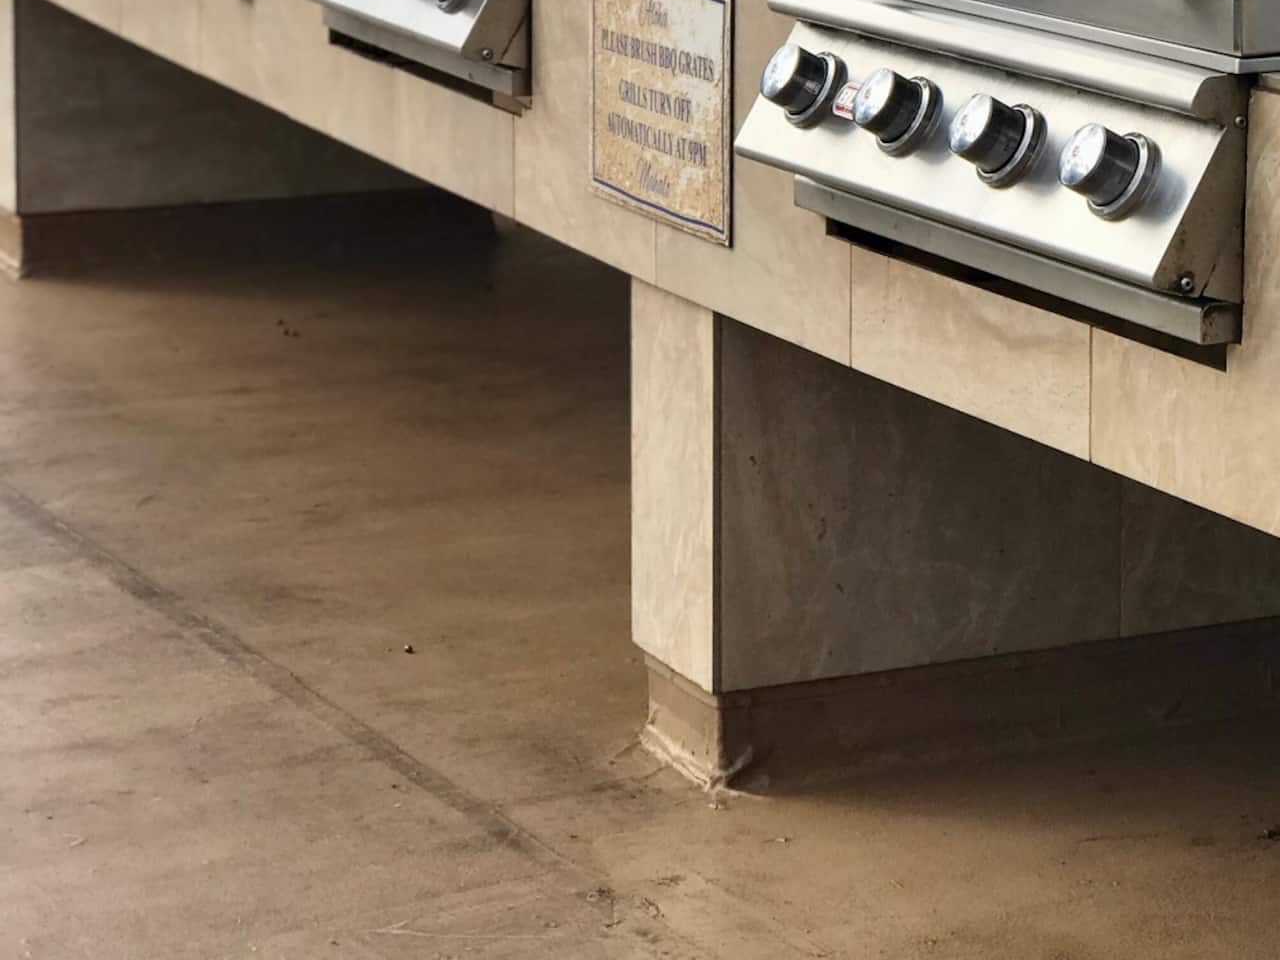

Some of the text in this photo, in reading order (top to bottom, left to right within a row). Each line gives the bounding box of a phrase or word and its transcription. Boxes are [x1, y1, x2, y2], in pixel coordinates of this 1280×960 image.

[601, 28, 714, 82] PLEASE BRUSH BBQ GRATES
[618, 78, 692, 123] GRILLS TURN OFF
[607, 111, 707, 167] AUTOMATICALLY AT 9PM
